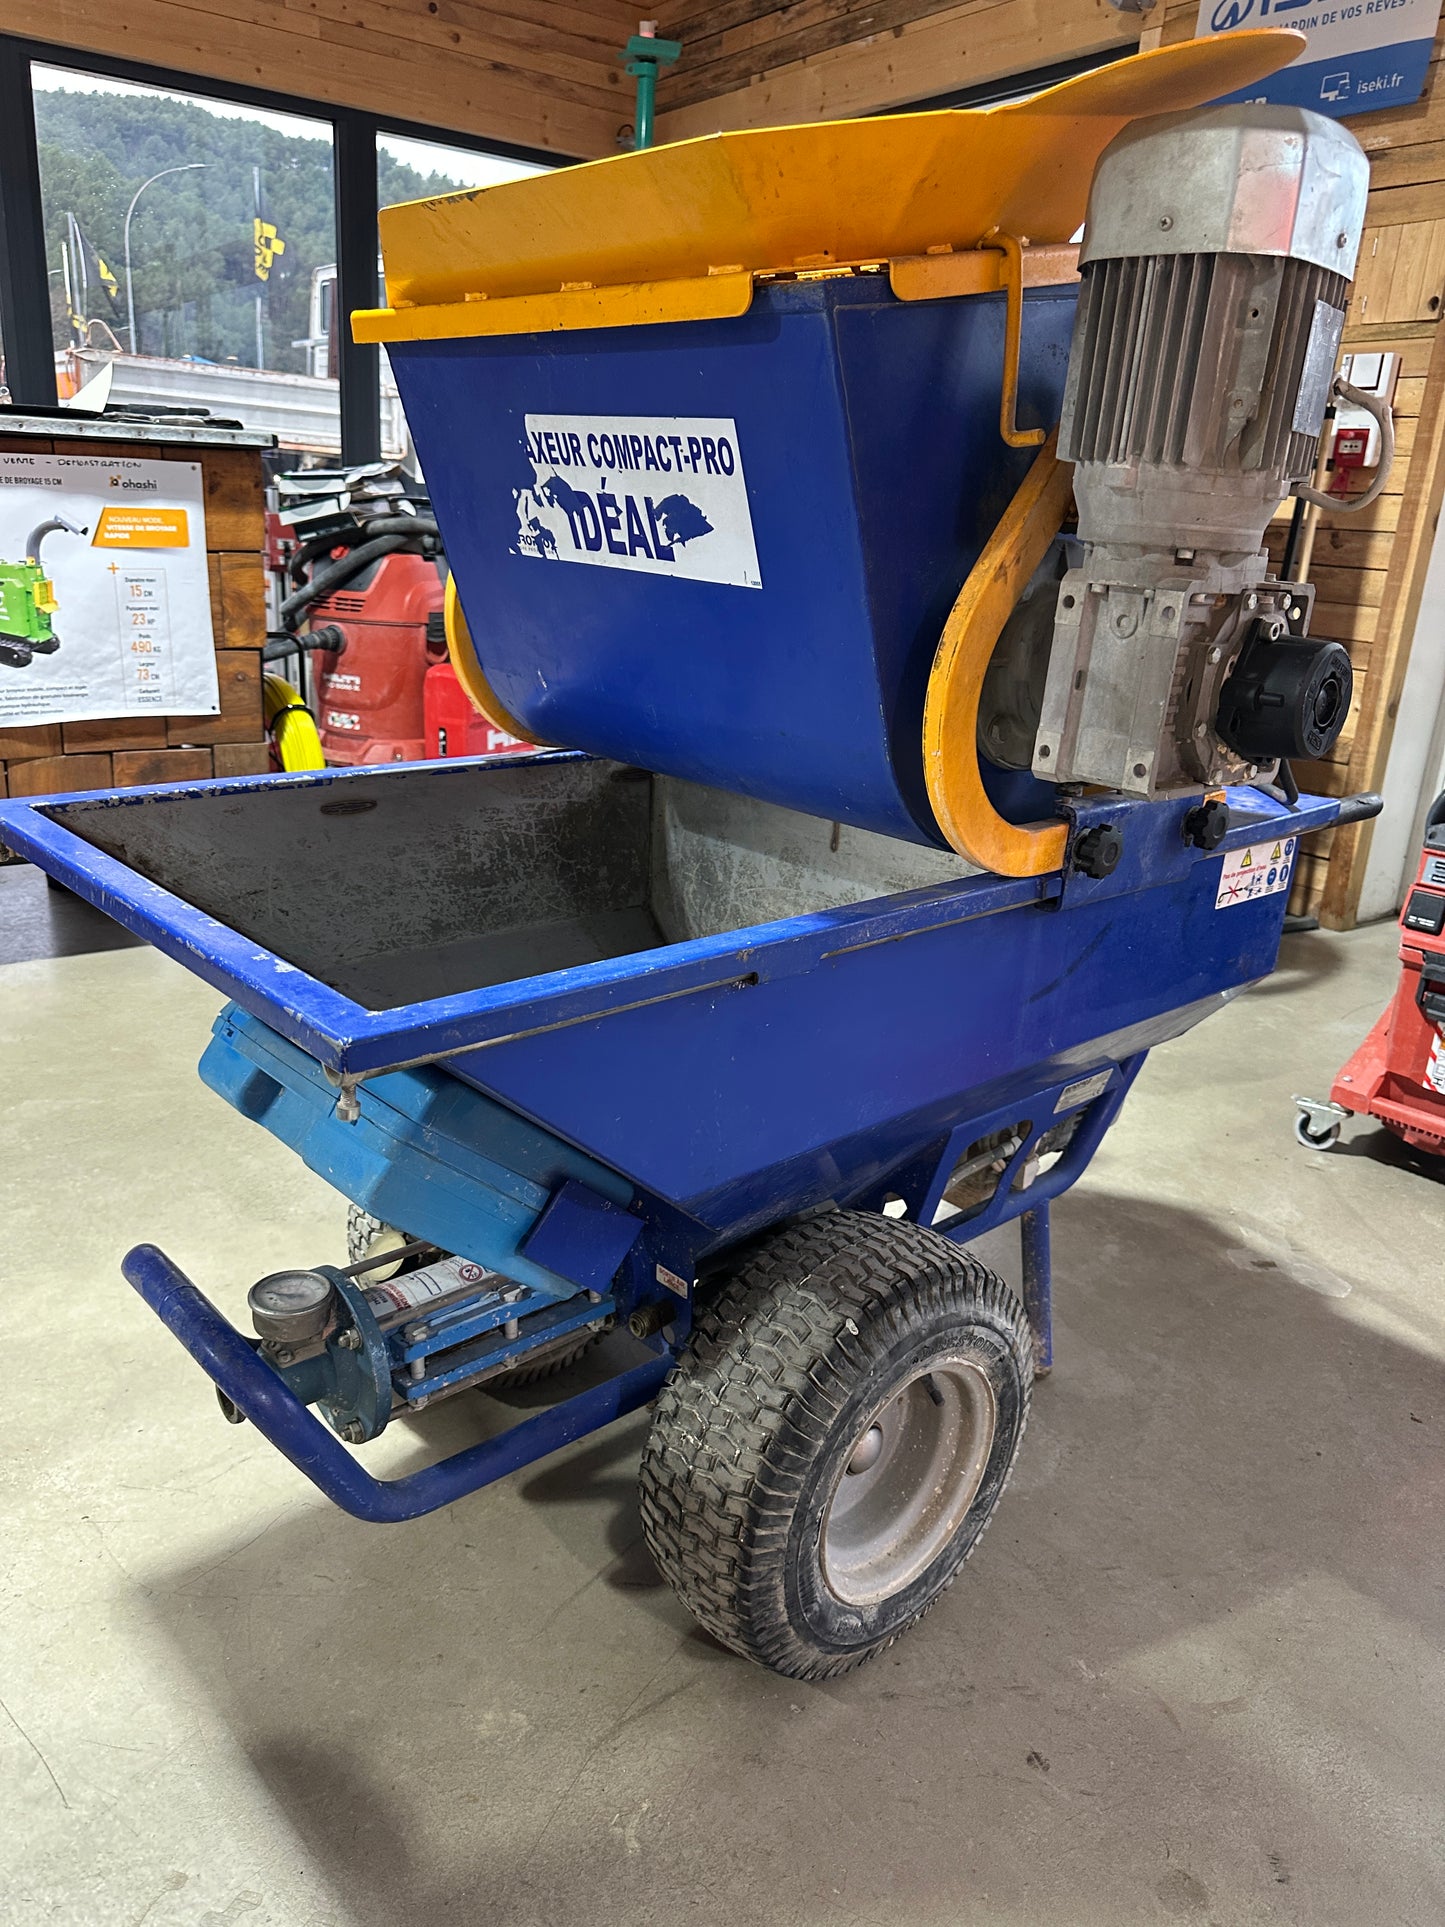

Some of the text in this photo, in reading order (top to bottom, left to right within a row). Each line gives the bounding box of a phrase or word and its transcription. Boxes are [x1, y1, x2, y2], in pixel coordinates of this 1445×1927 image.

[1321, 11, 1338, 25] DE
[1341, 4, 1363, 19] VOS
[1357, 73, 1404, 94] iseki.fr
[587, 432, 735, 477] COMPACT-PRO
[5, 476, 13, 484] DE
[14, 476, 43, 485] BROYAGE
[44, 477, 51, 485] 15
[121, 479, 158, 490] ohashi
[566, 477, 676, 562] IDÉAL
[130, 585, 142, 597] 15
[132, 613, 146, 625] 23
[131, 641, 152, 653] 490
[137, 668, 149, 680] 73
